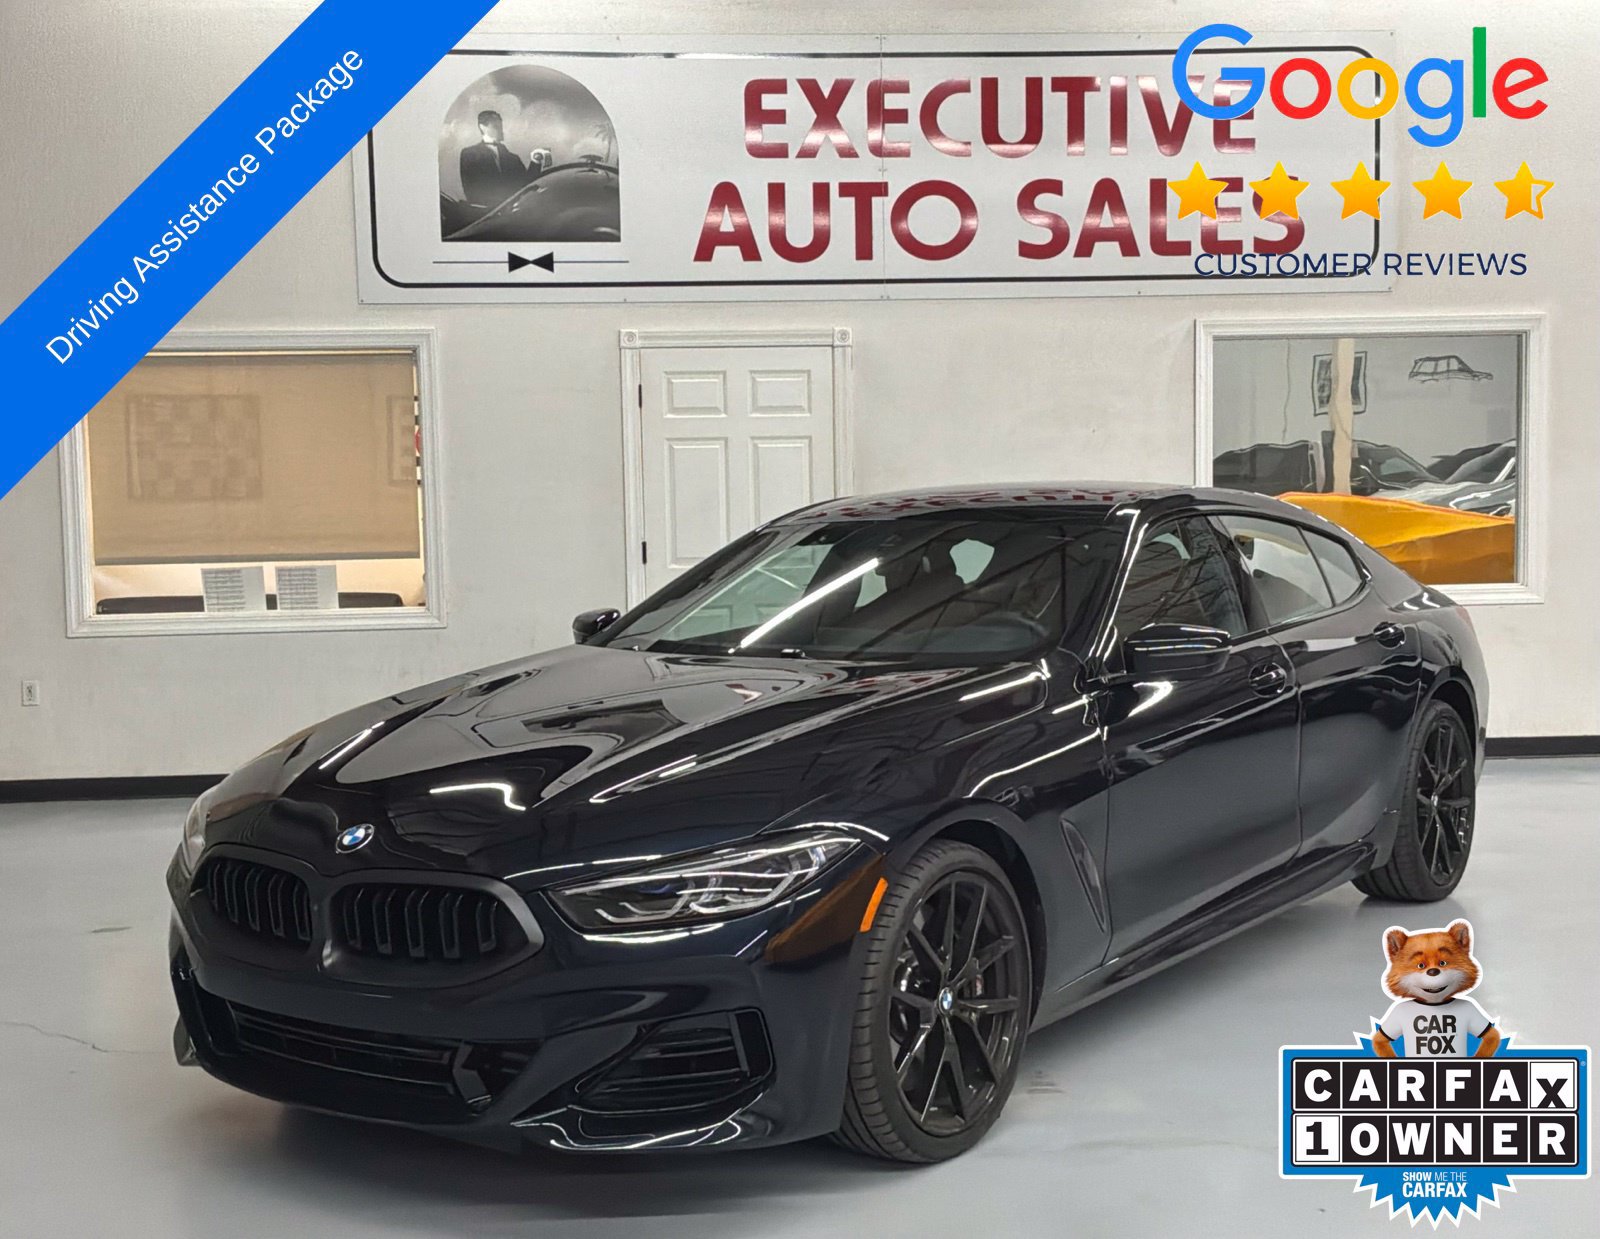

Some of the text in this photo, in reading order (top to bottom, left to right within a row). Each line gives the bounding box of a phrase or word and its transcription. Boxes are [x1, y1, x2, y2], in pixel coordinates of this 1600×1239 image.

[743, 75, 1256, 159] EXECUTIVE
[693, 175, 1306, 263] AUTO SALES
